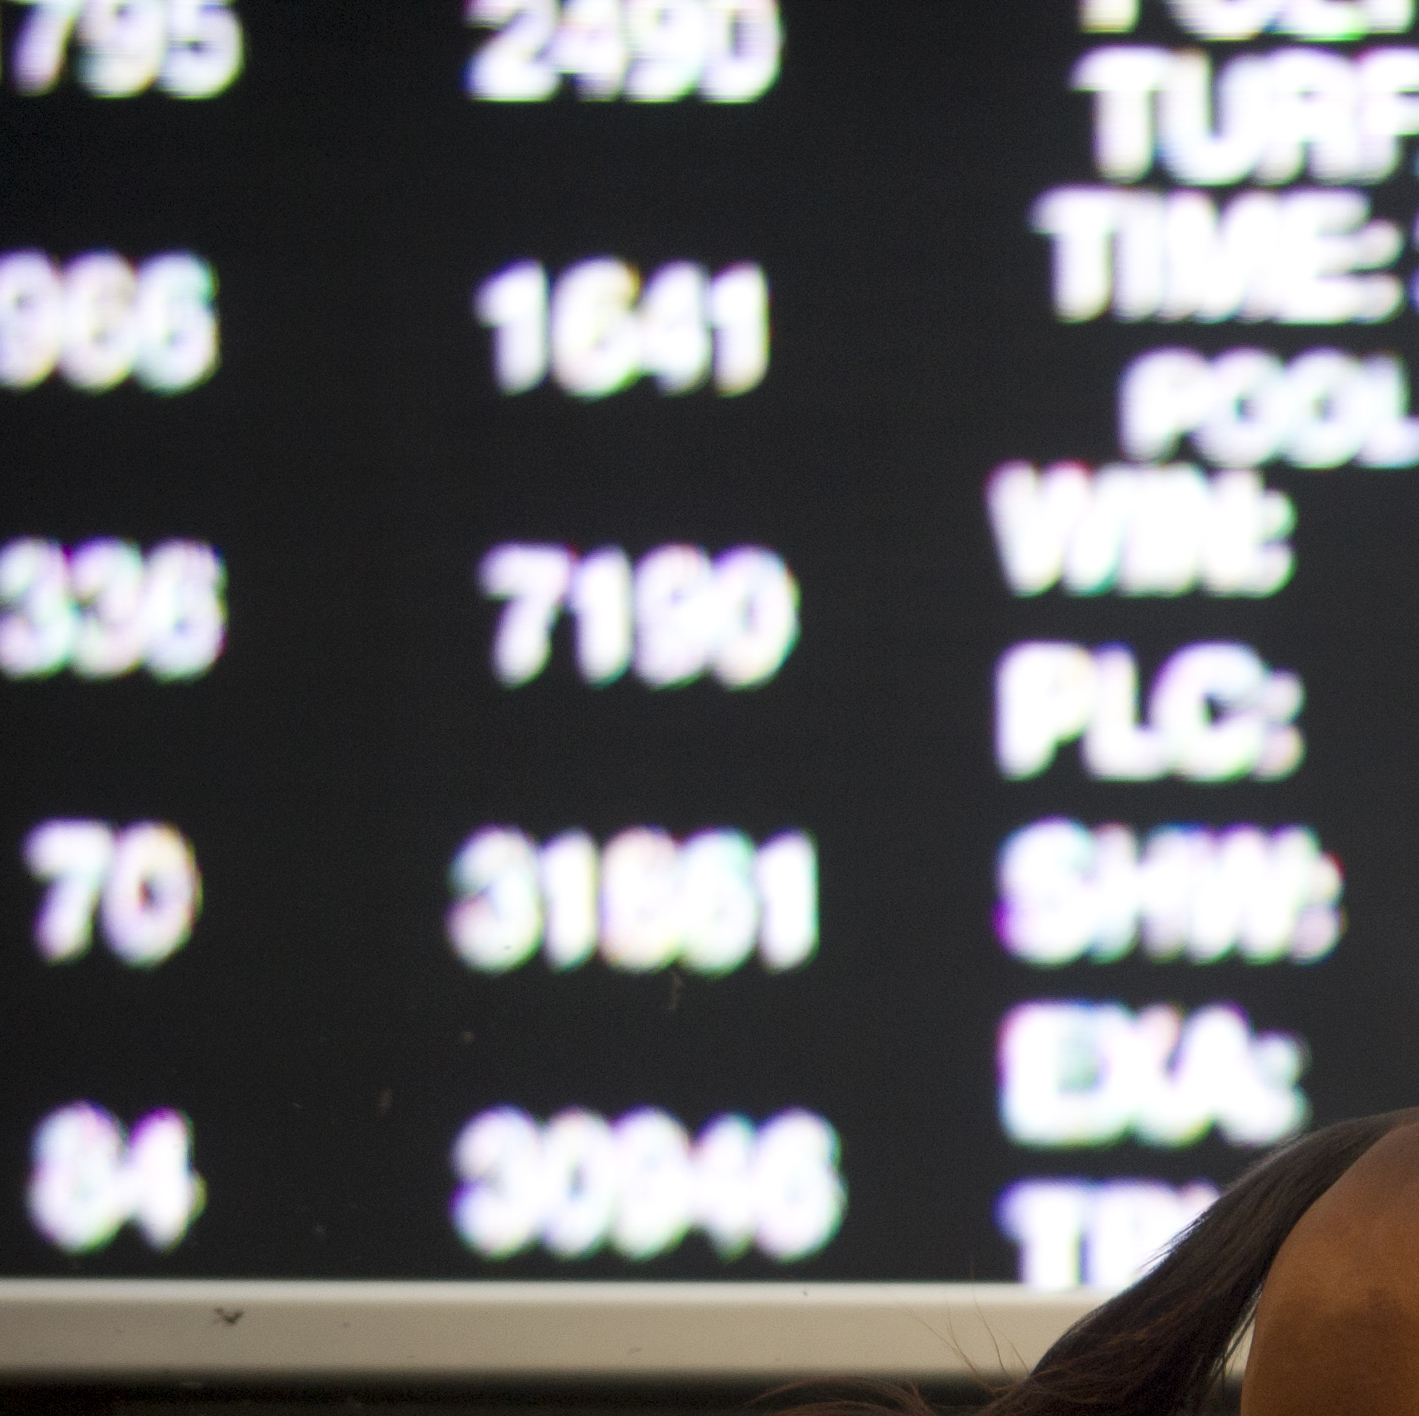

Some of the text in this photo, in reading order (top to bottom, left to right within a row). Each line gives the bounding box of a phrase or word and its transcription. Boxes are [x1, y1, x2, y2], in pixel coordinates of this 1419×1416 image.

[1036, 190, 1402, 324] TIME:
[480, 259, 768, 396] 1641
[996, 641, 1302, 781] PLC:
[28, 820, 197, 960] 70
